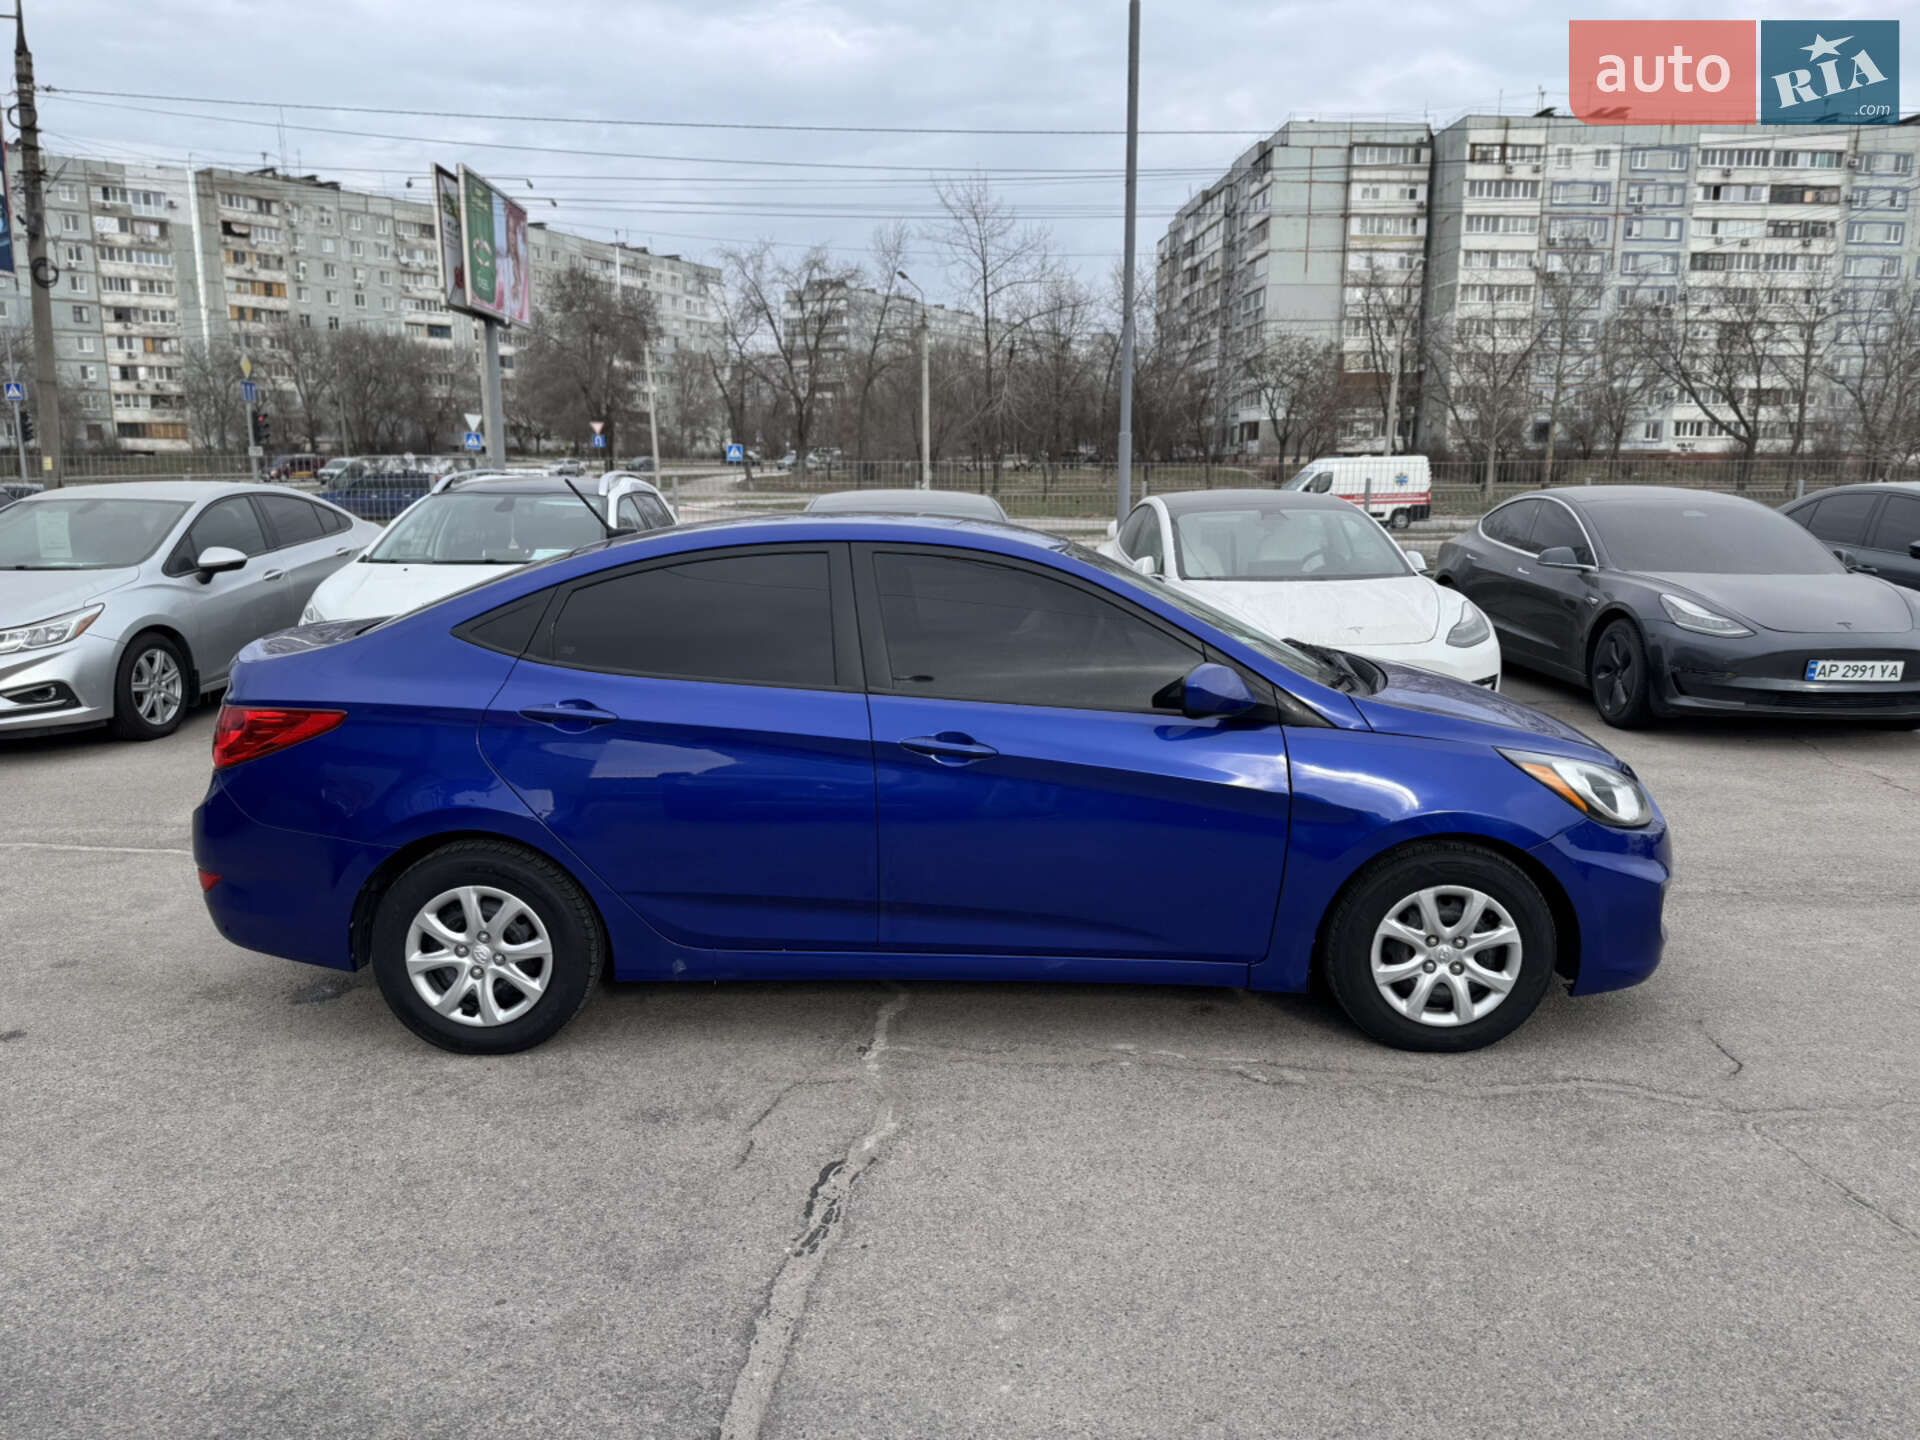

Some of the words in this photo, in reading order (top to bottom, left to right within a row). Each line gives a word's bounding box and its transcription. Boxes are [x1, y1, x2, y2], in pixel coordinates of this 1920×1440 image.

[1817, 664, 1839, 678] AP
[1841, 664, 1875, 678] 2991
[1880, 664, 1899, 678] YA
